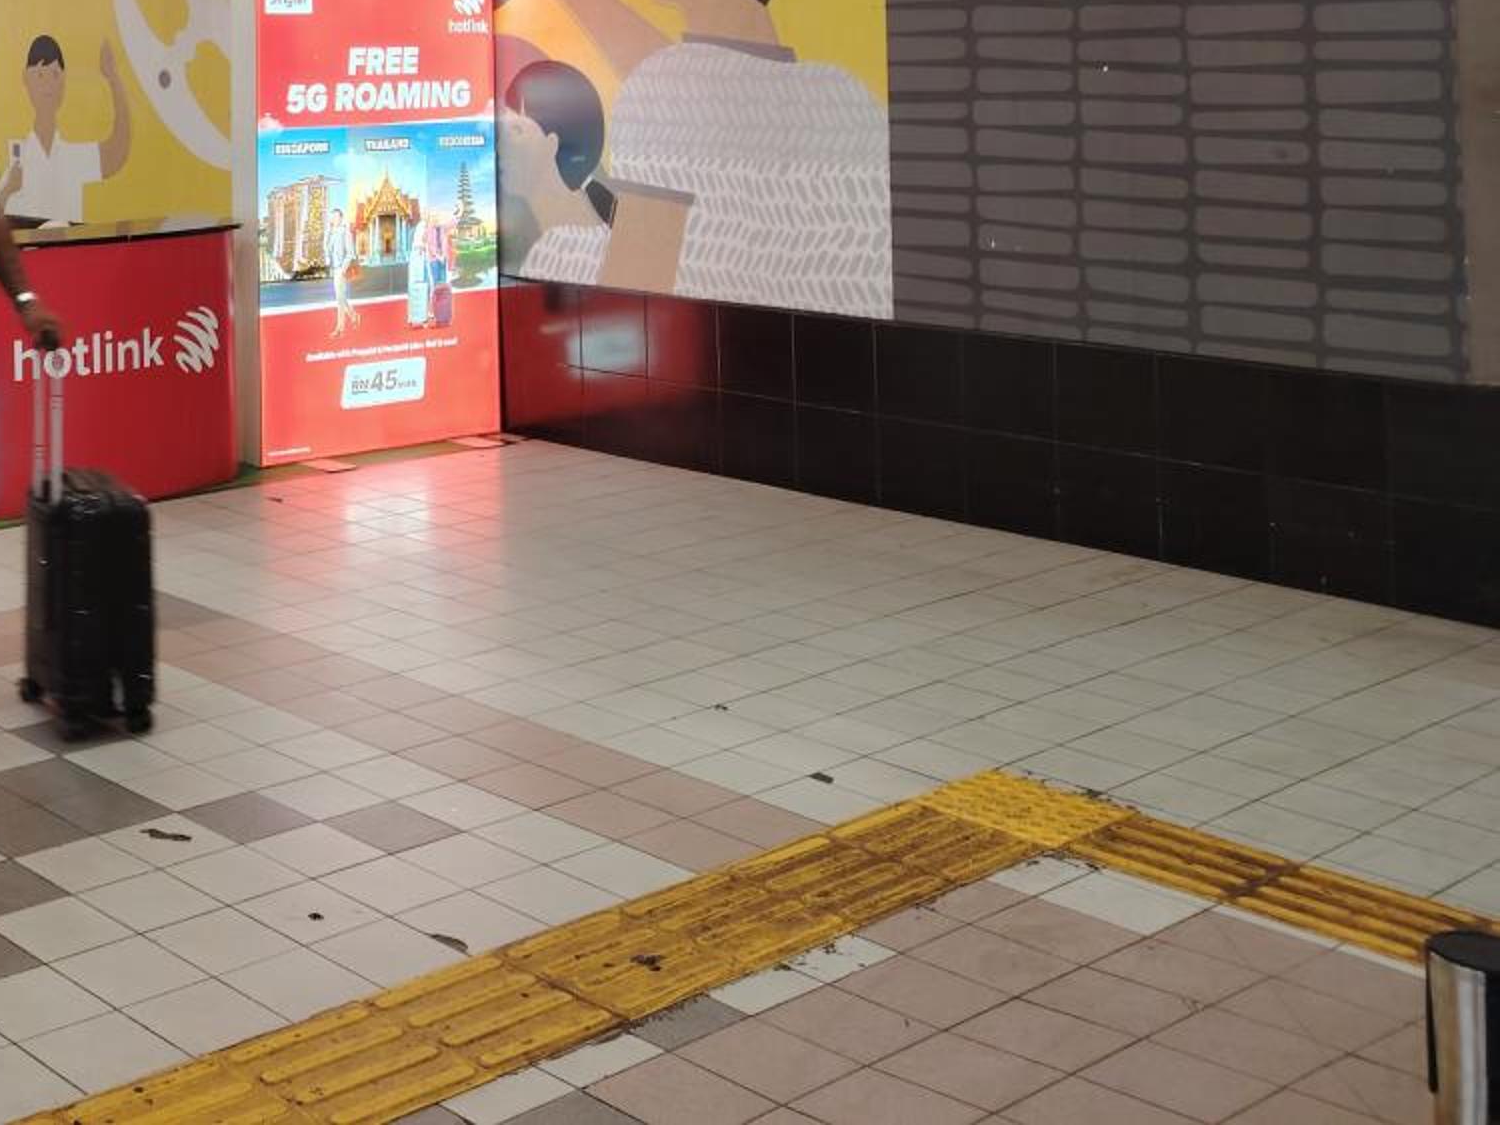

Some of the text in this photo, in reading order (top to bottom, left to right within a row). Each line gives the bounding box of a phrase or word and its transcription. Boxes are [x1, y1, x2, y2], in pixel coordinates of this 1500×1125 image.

[348, 47, 420, 76] FREE
[286, 80, 471, 113] 5G ROAMING
[13, 327, 164, 381] hotlink
